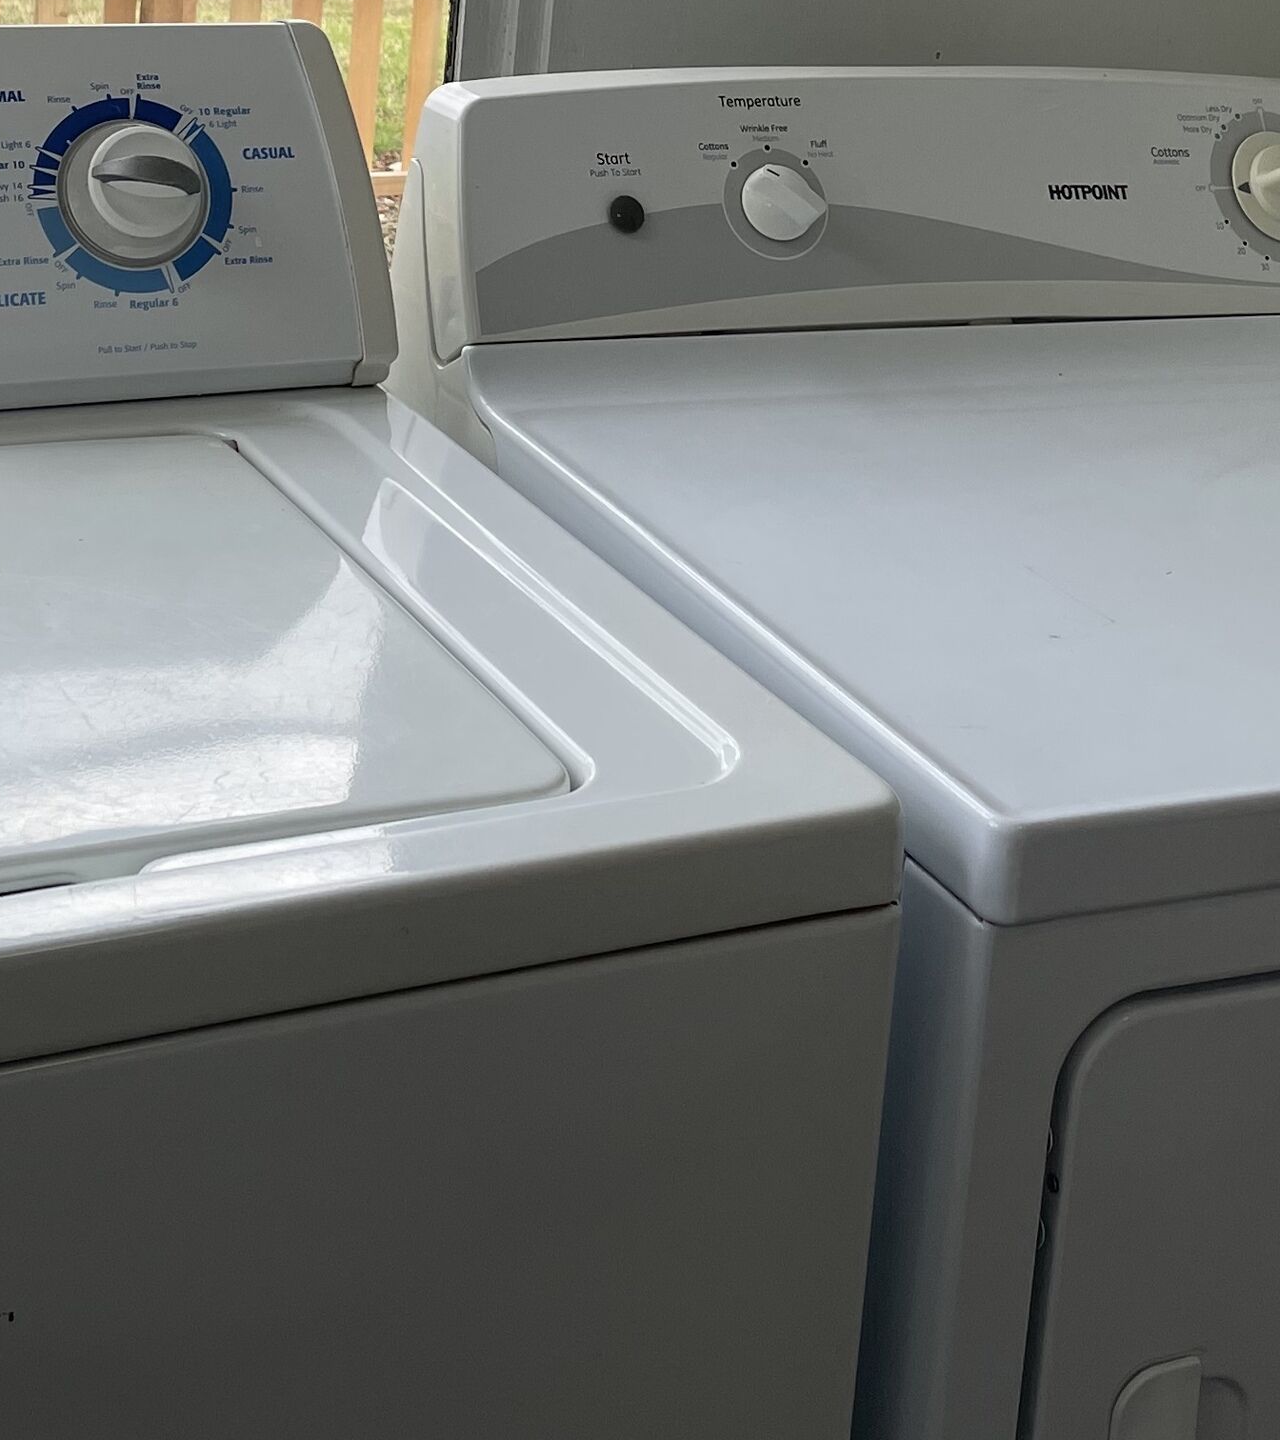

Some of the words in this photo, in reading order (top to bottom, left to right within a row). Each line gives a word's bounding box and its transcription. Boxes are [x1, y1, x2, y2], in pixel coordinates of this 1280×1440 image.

[136, 74, 160, 82] Extra
[90, 82, 110, 92] Spin
[137, 82, 161, 90] Rinse
[47, 96, 71, 104] Rinse
[718, 95, 801, 110] Temperature
[198, 108, 211, 116] 10
[213, 106, 251, 117] Regular
[217, 120, 238, 129] Light
[740, 124, 769, 133] Wrinkle
[770, 124, 788, 133] Free
[1, 141, 23, 151] Light
[698, 143, 729, 151] Cottons
[242, 146, 295, 160] CASUAL
[1151, 146, 1190, 158] Cottons
[596, 152, 631, 165] Start
[13, 161, 25, 170] 10
[590, 169, 608, 178] Push
[611, 168, 620, 177] To
[622, 168, 641, 177] Start
[241, 185, 264, 193] Rinse
[1048, 184, 1128, 201] HOTPOINT
[238, 226, 257, 235] Spin
[23, 256, 49, 265] Rinse
[224, 257, 247, 265] Extra
[249, 256, 273, 264] Rinse
[56, 281, 76, 291] Spin
[94, 300, 117, 308] Rinse
[130, 298, 169, 311] Regular
[172, 298, 179, 307] 6
[124, 344, 142, 353] Start
[150, 343, 168, 351] Push
[180, 341, 197, 350] Stop
